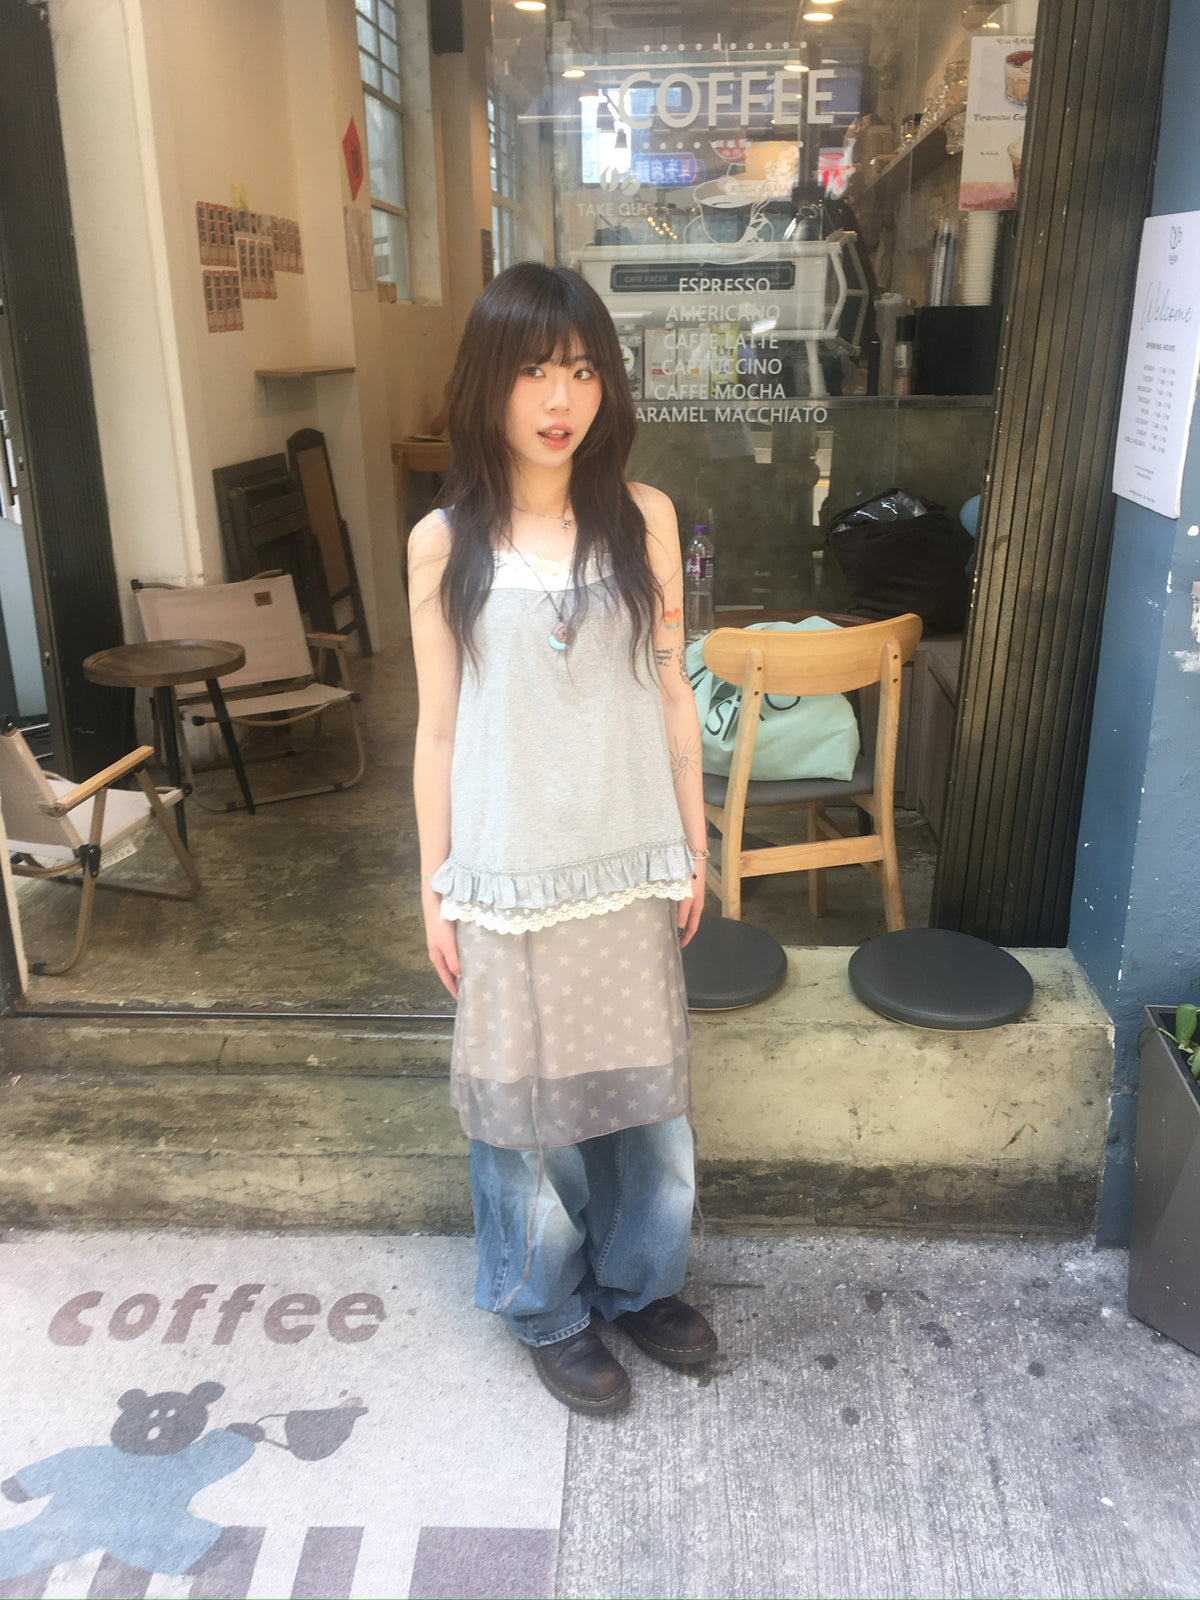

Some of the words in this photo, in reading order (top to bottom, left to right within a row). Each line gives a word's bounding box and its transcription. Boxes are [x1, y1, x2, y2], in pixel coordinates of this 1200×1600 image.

[618, 69, 835, 129] COFFEE
[1013, 113, 1026, 121] Co
[576, 202, 615, 217] TAKE
[618, 202, 653, 217] OUT
[678, 277, 771, 295] ESPRESSO
[665, 304, 781, 322] AMERICANO
[1140, 281, 1193, 330] Welcome
[663, 333, 718, 350] CAFFE
[725, 333, 779, 350] LATTE
[660, 358, 783, 375] CAPPUCCINO
[654, 384, 709, 401] CAFFE
[715, 383, 786, 400] MOCHA
[636, 407, 708, 424] ARAMEL
[715, 406, 828, 424] MACCHIATO
[48, 1283, 386, 1347] coffee
